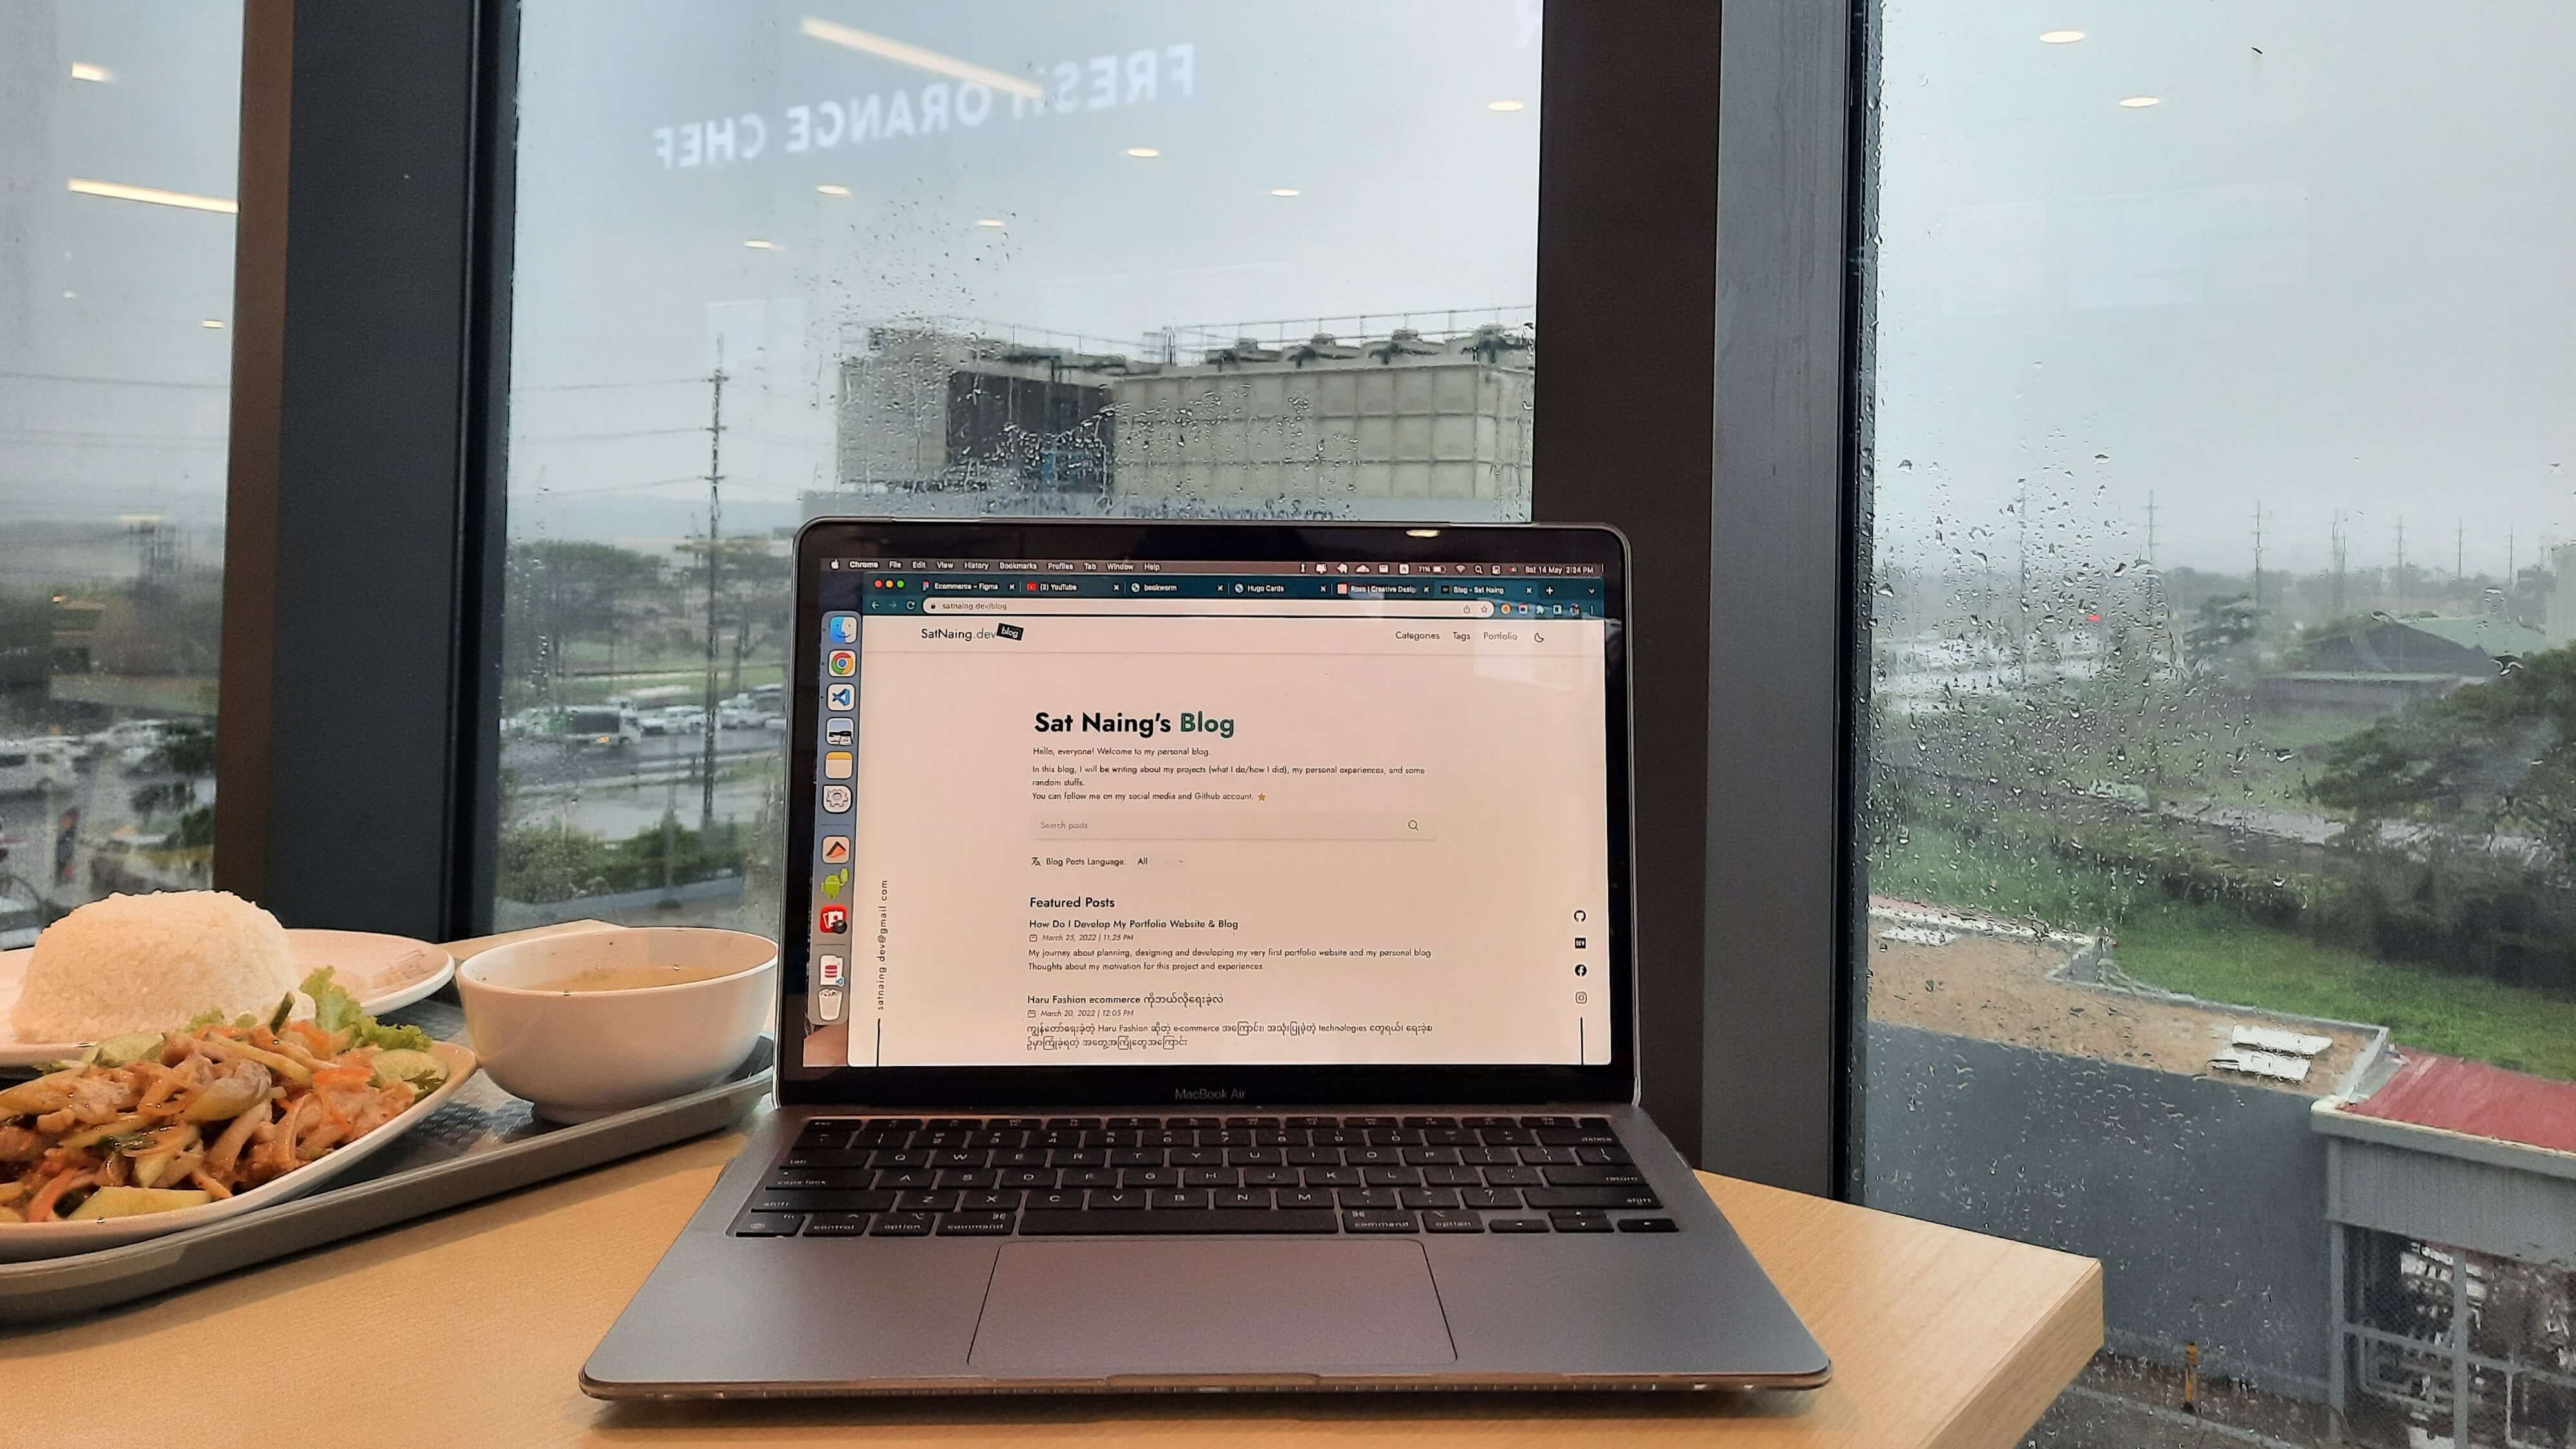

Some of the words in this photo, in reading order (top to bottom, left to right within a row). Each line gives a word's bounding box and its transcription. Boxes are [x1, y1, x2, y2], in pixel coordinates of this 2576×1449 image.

[964, 562, 989, 571] History
[999, 562, 1037, 570] Bookmarks
[1107, 562, 1134, 571] Window
[1144, 563, 1160, 571] Help
[1548, 566, 1562, 574] May
[979, 583, 998, 591] Figma
[1247, 585, 1265, 593] Hugo
[1454, 586, 1468, 594] Blog
[1486, 586, 1504, 595] Naing
[1000, 625, 1020, 639] blog
[1395, 630, 1440, 641] Categories
[1452, 631, 1471, 642] Tags
[1483, 631, 1518, 641] Portfolio
[1035, 712, 1073, 732] Sat
[1083, 712, 1171, 738] Naing's
[1181, 711, 1234, 738] Blog
[1033, 746, 1055, 757] Hello,
[1057, 747, 1094, 757] everyone!
[1096, 746, 1132, 755] Welcome
[1157, 746, 1189, 757] personal
[1191, 747, 1211, 757] blog.
[1041, 764, 1056, 773] this
[1084, 764, 1097, 773] will
[1099, 764, 1110, 773] be
[1112, 766, 1137, 775] writing
[1176, 765, 1206, 775] projects
[1235, 764, 1265, 774] do/how
[1305, 765, 1337, 775] personal
[1388, 766, 1403, 774] and
[1032, 778, 1061, 786] random
[1064, 791, 1087, 800] follow
[1128, 791, 1150, 800] social
[1152, 791, 1176, 800] media
[1177, 791, 1193, 800] and
[1194, 791, 1220, 800] Github
[1040, 820, 1066, 829] Search
[1068, 822, 1088, 830] posts
[1046, 857, 1063, 867] Blog
[1066, 857, 1085, 866] Posts
[1137, 857, 1148, 866] All
[1030, 896, 1081, 908] Featured
[1085, 896, 1115, 908] Posts
[1029, 920, 1050, 928] How
[1052, 920, 1065, 928] Do
[1074, 919, 1110, 931] Develop
[1113, 920, 1127, 930] My
[1130, 918, 1167, 928] Portfolio
[1169, 918, 1206, 928] Website
[1218, 918, 1238, 931] Blog
[1042, 933, 1063, 942] March
[876, 881, 888, 1010] satnaing.dev@gmailcom
[1028, 949, 1040, 958] My
[1041, 949, 1071, 958] journey
[1072, 948, 1095, 956] about
[1097, 948, 1133, 958] planning,
[1135, 947, 1173, 958] designing
[1175, 947, 1190, 956] and
[1191, 947, 1235, 958] developing
[1268, 947, 1282, 956] first
[1284, 947, 1317, 958] portfolio
[1319, 948, 1347, 956] website
[1349, 947, 1364, 956] and
[1379, 948, 1412, 958] personal
[1028, 961, 1063, 972] Thoughts
[1065, 962, 1086, 971] about
[1143, 961, 1155, 970] for
[1156, 961, 1170, 970] this
[1171, 963, 1199, 972] project
[1200, 961, 1215, 970] and
[1027, 995, 1050, 1004] Haru
[1052, 994, 1086, 1004] Fashion
[1097, 1024, 1117, 1032] Haru
[1119, 1023, 1148, 1032] Fashion
[1318, 1023, 1367, 1034] technologies
[1175, 1088, 1227, 1100] MacBook
[1231, 1088, 1246, 1100] Air
